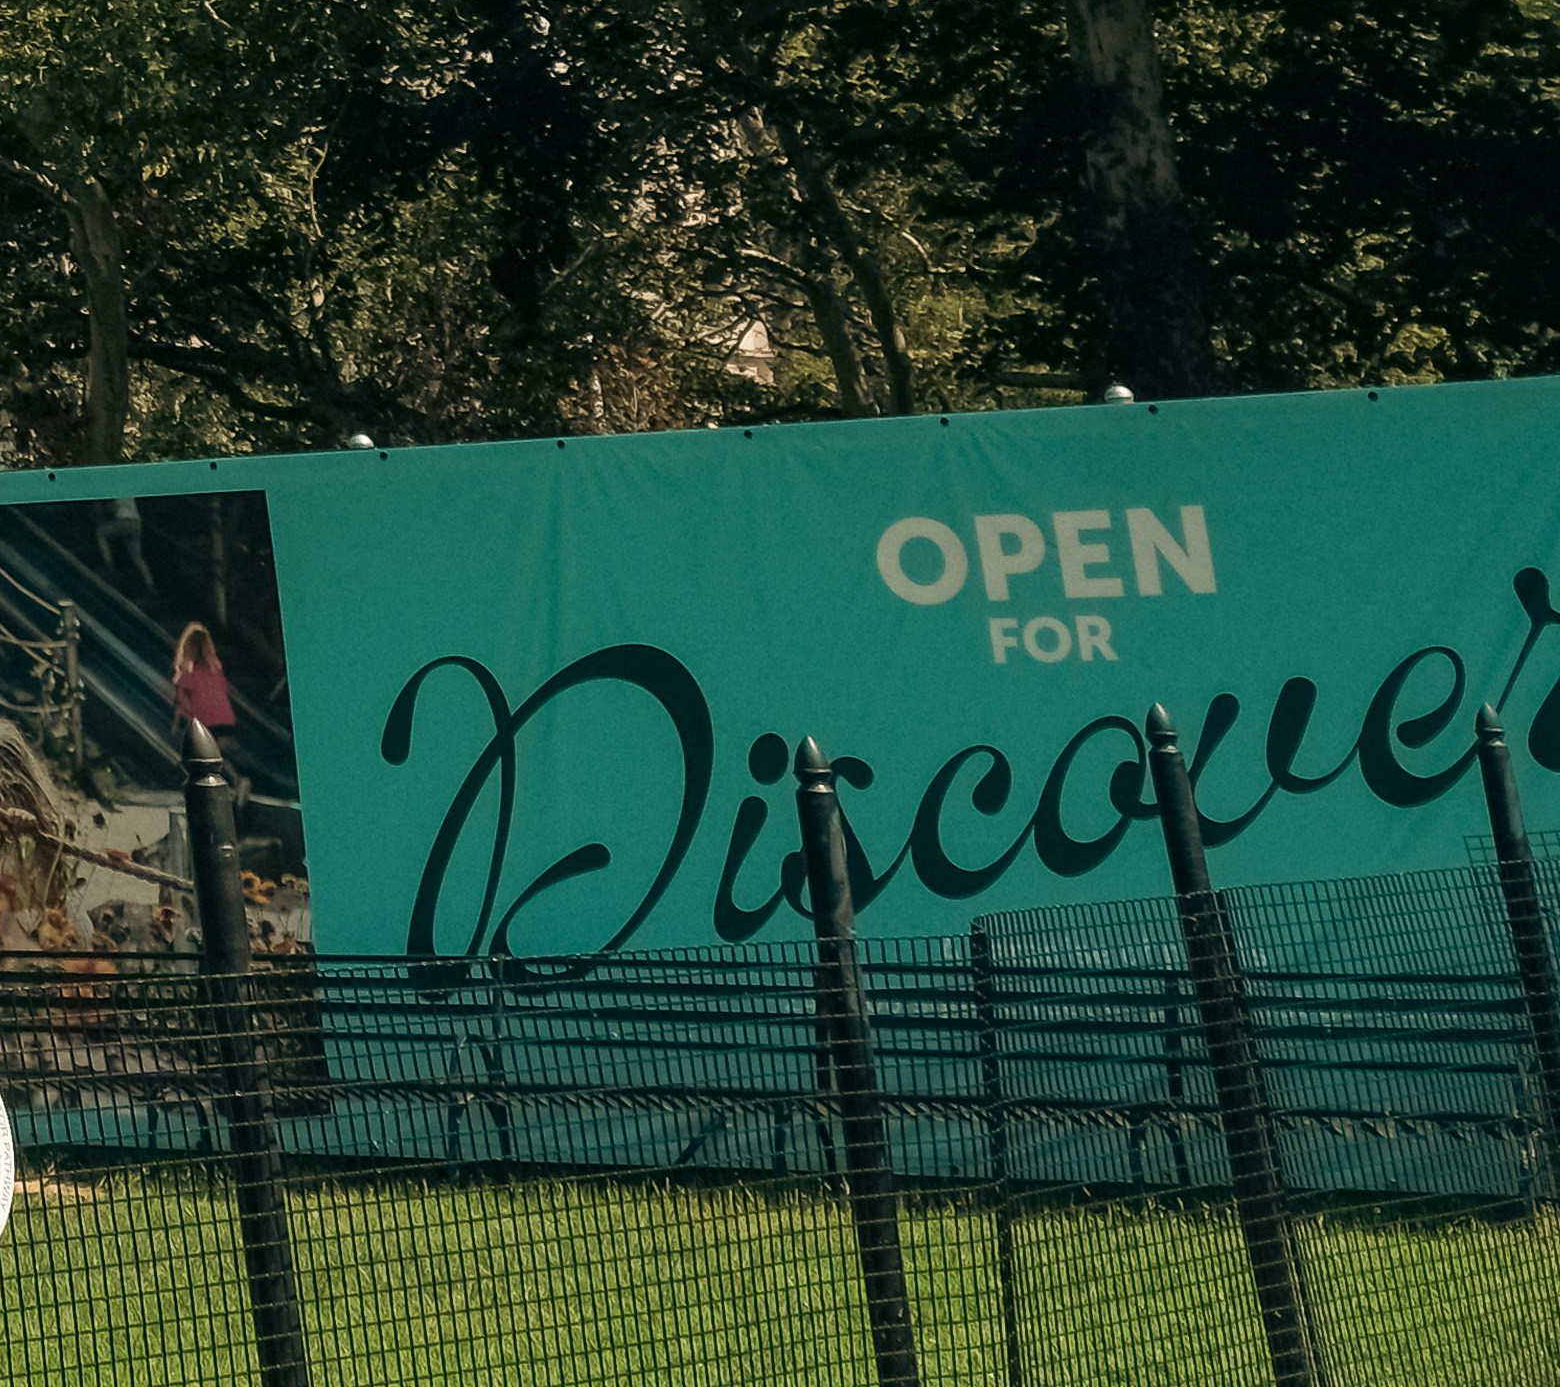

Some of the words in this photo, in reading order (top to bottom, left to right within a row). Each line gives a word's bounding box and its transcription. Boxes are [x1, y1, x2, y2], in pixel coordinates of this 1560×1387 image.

[875, 505, 1219, 607] OPEN
[988, 615, 1118, 665] FOR
[0, 1142, 12, 1212] PATHWAY
